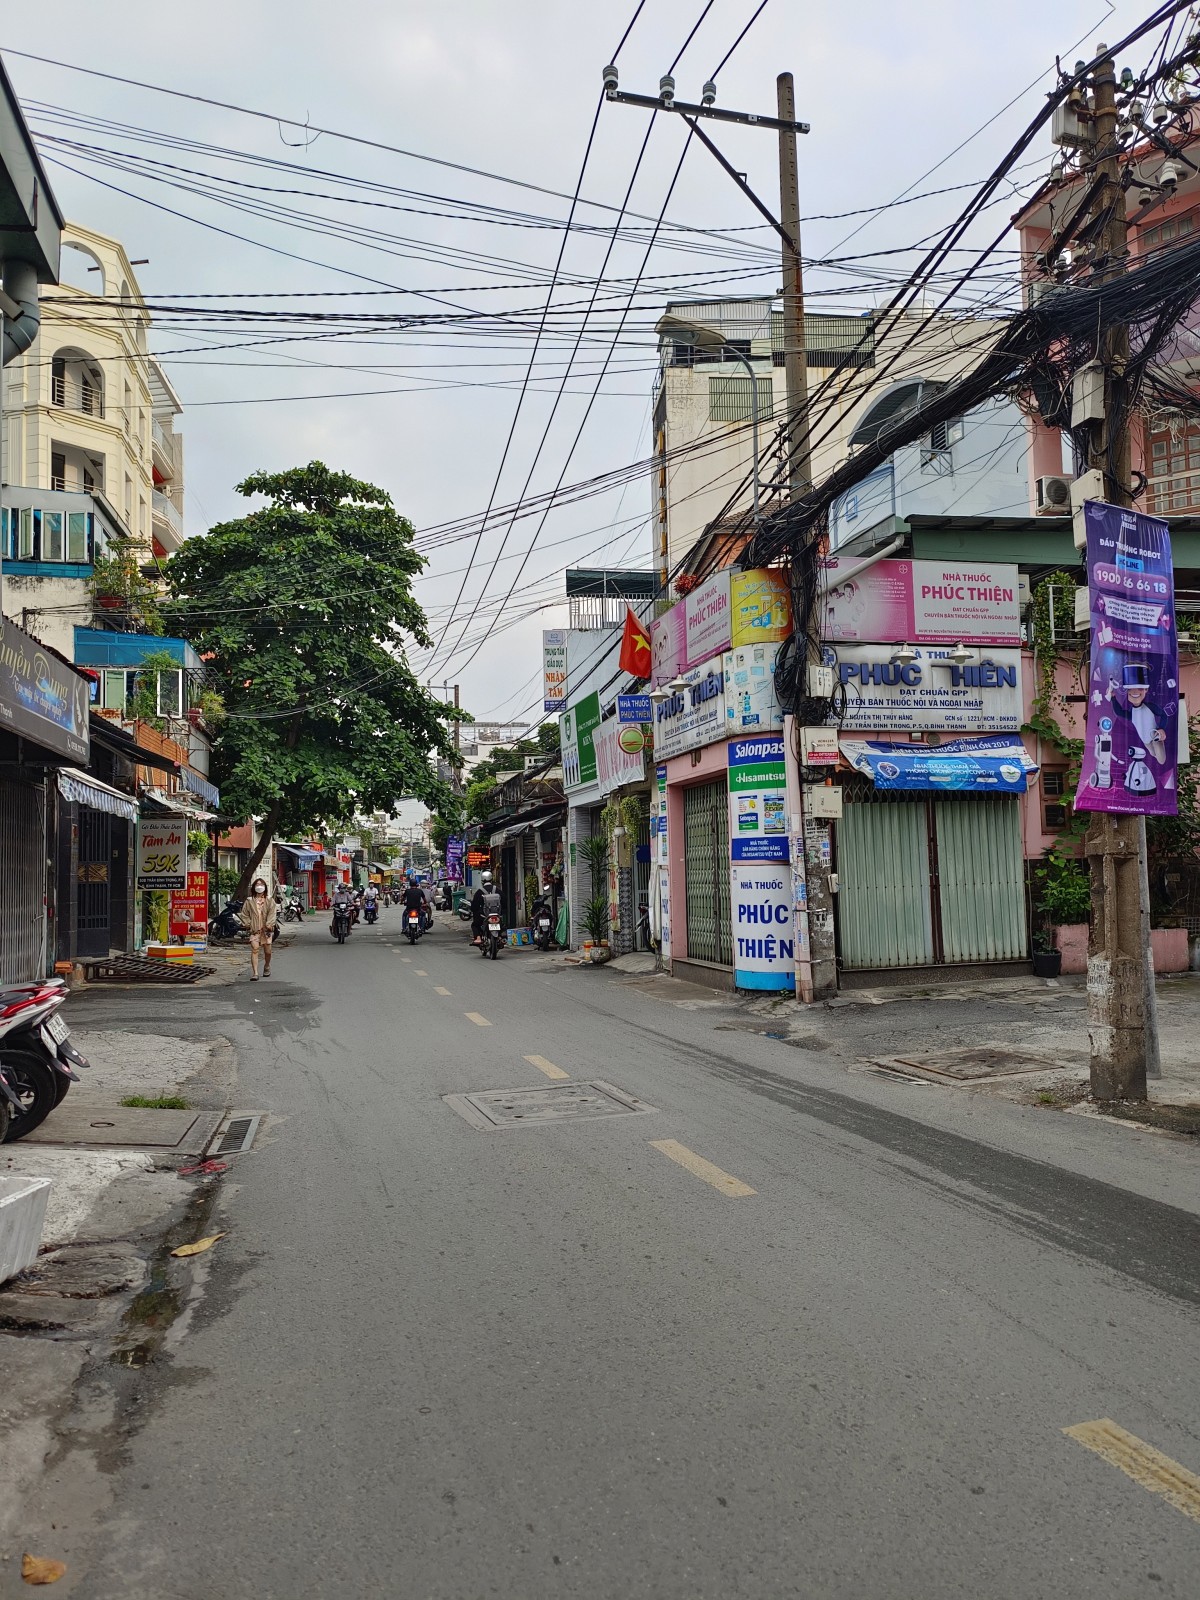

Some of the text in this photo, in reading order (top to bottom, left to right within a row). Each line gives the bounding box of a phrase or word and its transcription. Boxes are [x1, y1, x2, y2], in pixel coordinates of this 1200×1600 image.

[1139, 548, 1161, 559] ROBOT
[942, 572, 992, 582] NHÀ THUỐC
[1097, 569, 1121, 584] 1900
[1137, 580, 1150, 591] 66
[1153, 582, 1167, 593] 18
[921, 584, 965, 600] PHÚC
[967, 585, 1014, 605] THIỆN
[688, 593, 727, 630] PHÚC THIỆN
[545, 647, 565, 656] TRUNG TÂM
[926, 649, 957, 659] THU
[547, 659, 555, 668] GIÁO
[545, 671, 566, 683] NHÂN
[839, 657, 923, 686] PHÚC
[548, 686, 563, 698] TÂM
[899, 688, 917, 696] ĐẠT
[919, 687, 949, 696] CHUẨN
[620, 697, 650, 708] NHÀ THUỐC
[656, 690, 685, 723] PHÚC
[834, 695, 984, 709] CUYÊN BÁN THUỐC NỘI VÀ NGOẠI NHẬP
[620, 709, 651, 720] PHÚC THIỆN
[872, 714, 882, 722] THỊ
[854, 721, 869, 729] TRẦN
[873, 721, 888, 729] BÌNH
[735, 742, 785, 758] Salonpas
[960, 743, 978, 751] BÌNH
[735, 772, 785, 784] Hisamitsu
[142, 832, 181, 848] Tâm An
[193, 875, 205, 885] Mi
[740, 878, 783, 889] NHÀ THUỐC
[190, 886, 205, 897] Đầu
[738, 899, 789, 924] PHÚC
[737, 934, 794, 963] THIỆN
